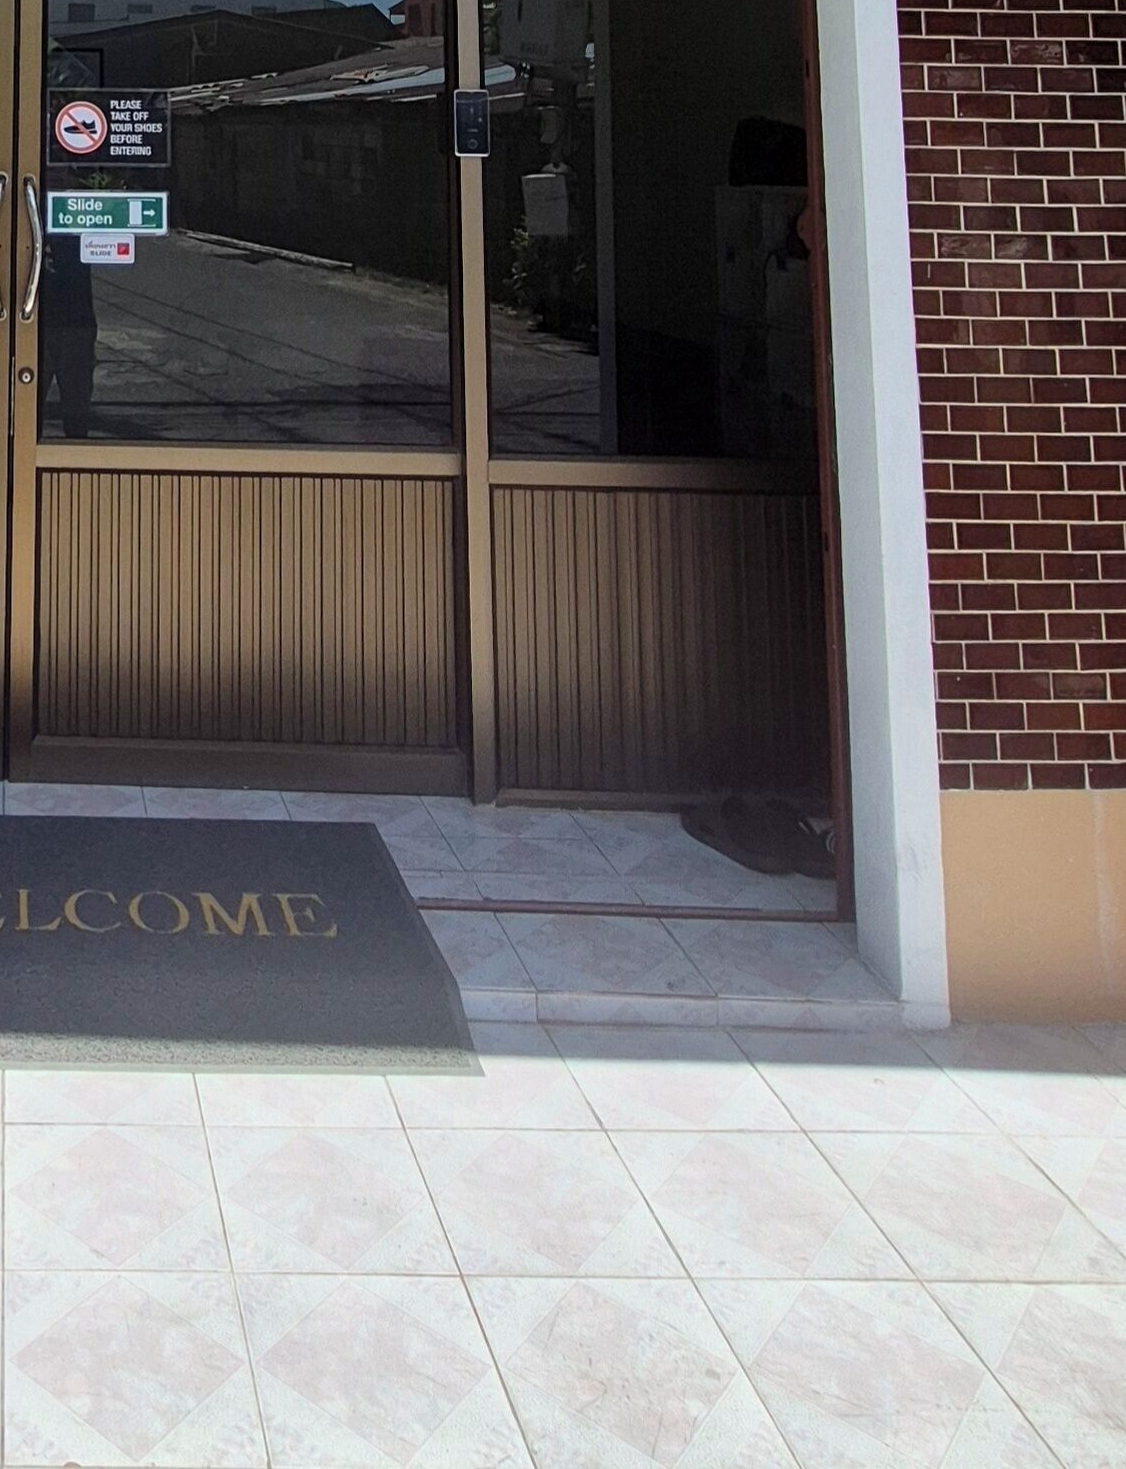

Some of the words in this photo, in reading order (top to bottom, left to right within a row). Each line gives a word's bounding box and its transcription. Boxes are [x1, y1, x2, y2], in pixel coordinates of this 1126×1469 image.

[110, 100, 142, 109] PLEASE
[110, 112, 131, 120] TAKE
[133, 112, 149, 120] OFF
[110, 124, 132, 132] YOUR
[135, 124, 162, 132] SHOES
[110, 134, 142, 144] BEFORE
[110, 146, 151, 155] ENTERING
[67, 198, 103, 211] Slide
[58, 213, 73, 224] to
[77, 215, 112, 226] open
